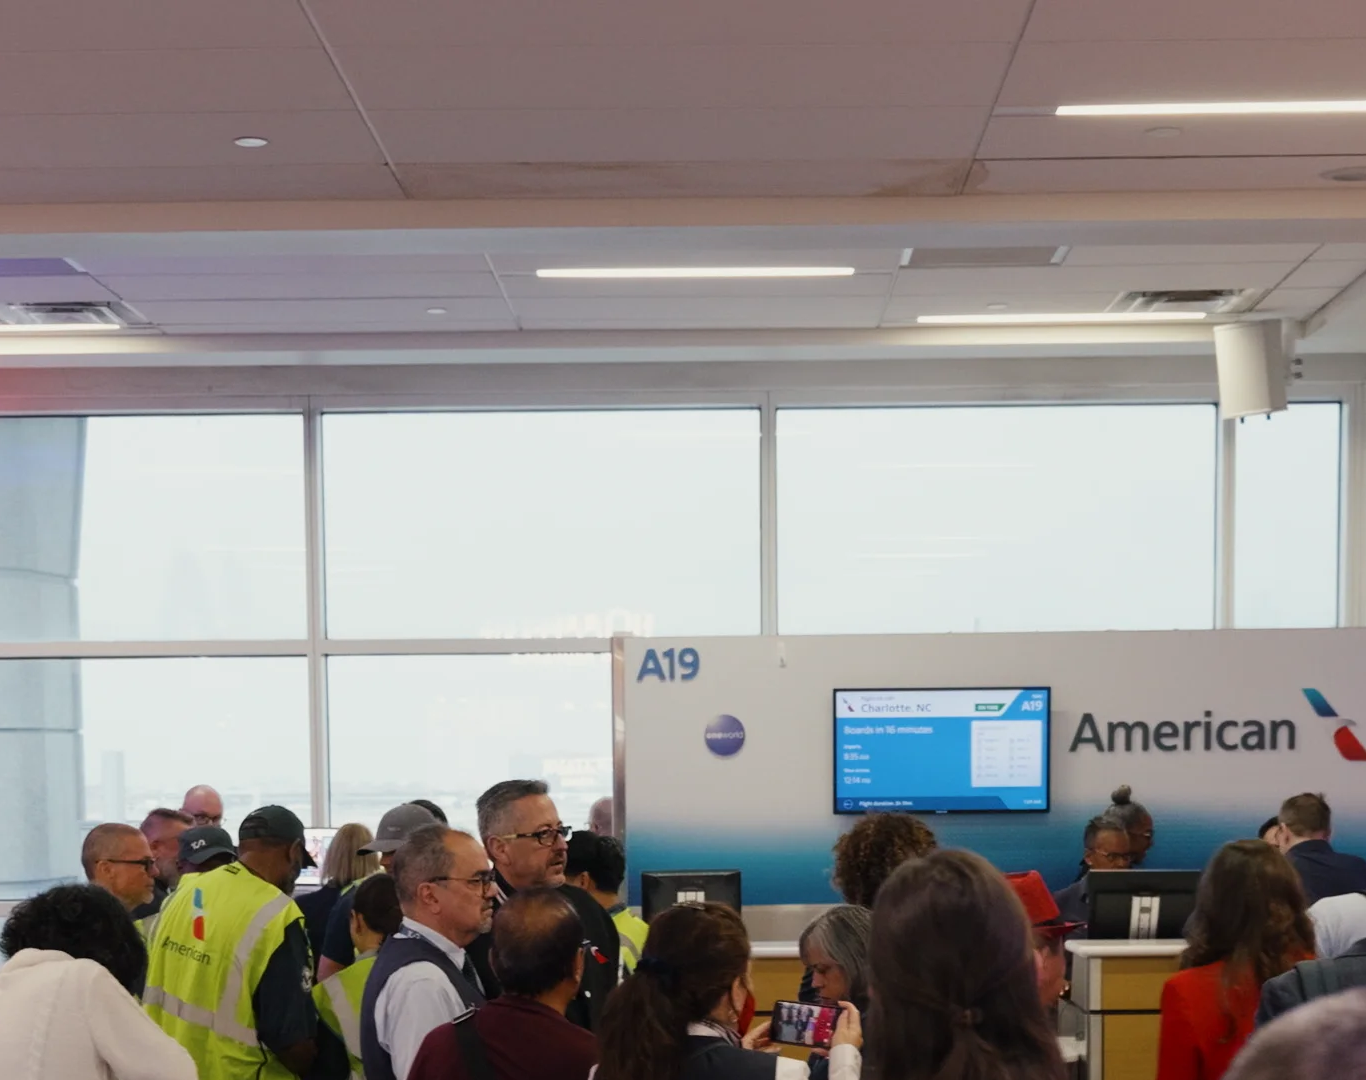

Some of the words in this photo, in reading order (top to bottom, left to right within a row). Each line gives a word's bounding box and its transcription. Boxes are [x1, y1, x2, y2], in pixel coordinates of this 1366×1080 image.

[637, 647, 700, 682] A19
[916, 703, 932, 713] NC
[1021, 700, 1043, 712] A19
[1069, 710, 1296, 752] American
